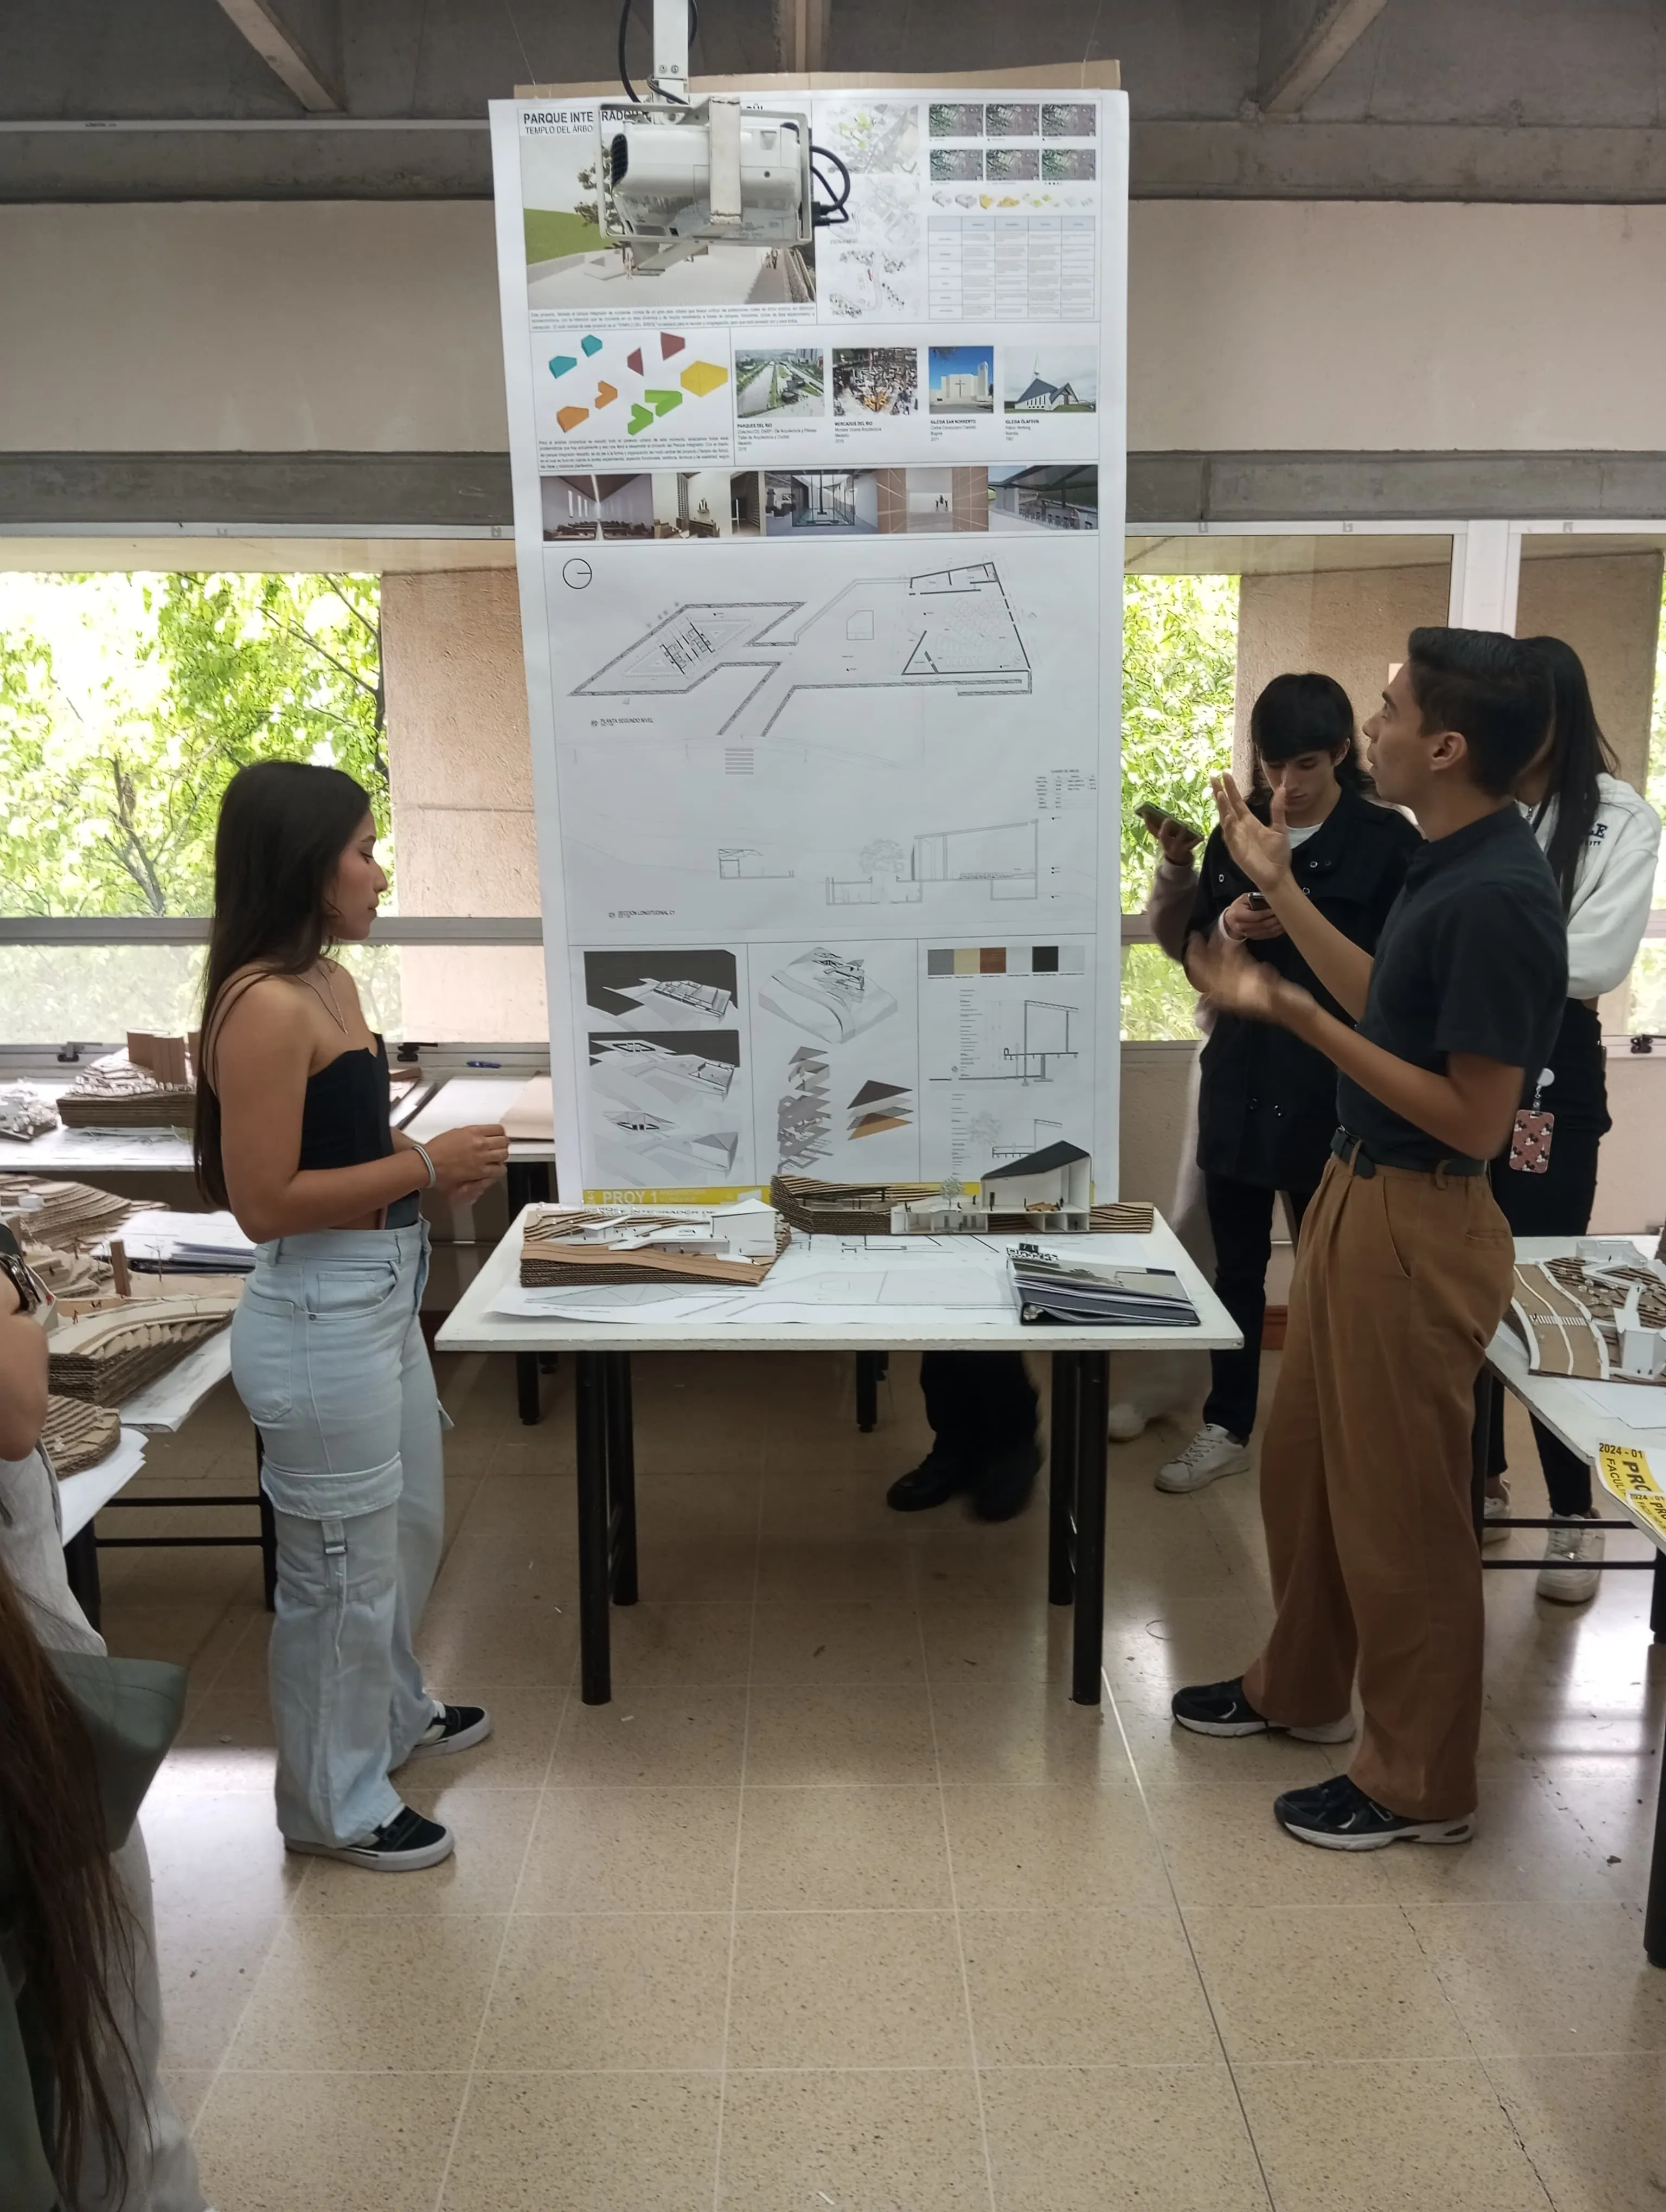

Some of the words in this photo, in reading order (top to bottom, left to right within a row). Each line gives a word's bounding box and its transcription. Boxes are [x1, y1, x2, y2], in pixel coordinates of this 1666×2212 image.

[523, 112, 567, 124] PARQUE
[525, 126, 555, 134] TEMPLO
[572, 124, 593, 132] ÁRBO
[603, 1191, 645, 1204] PROY
[650, 1190, 657, 1203] 1
[1599, 1443, 1622, 1455] 2024
[1631, 1449, 1643, 1458] 01
